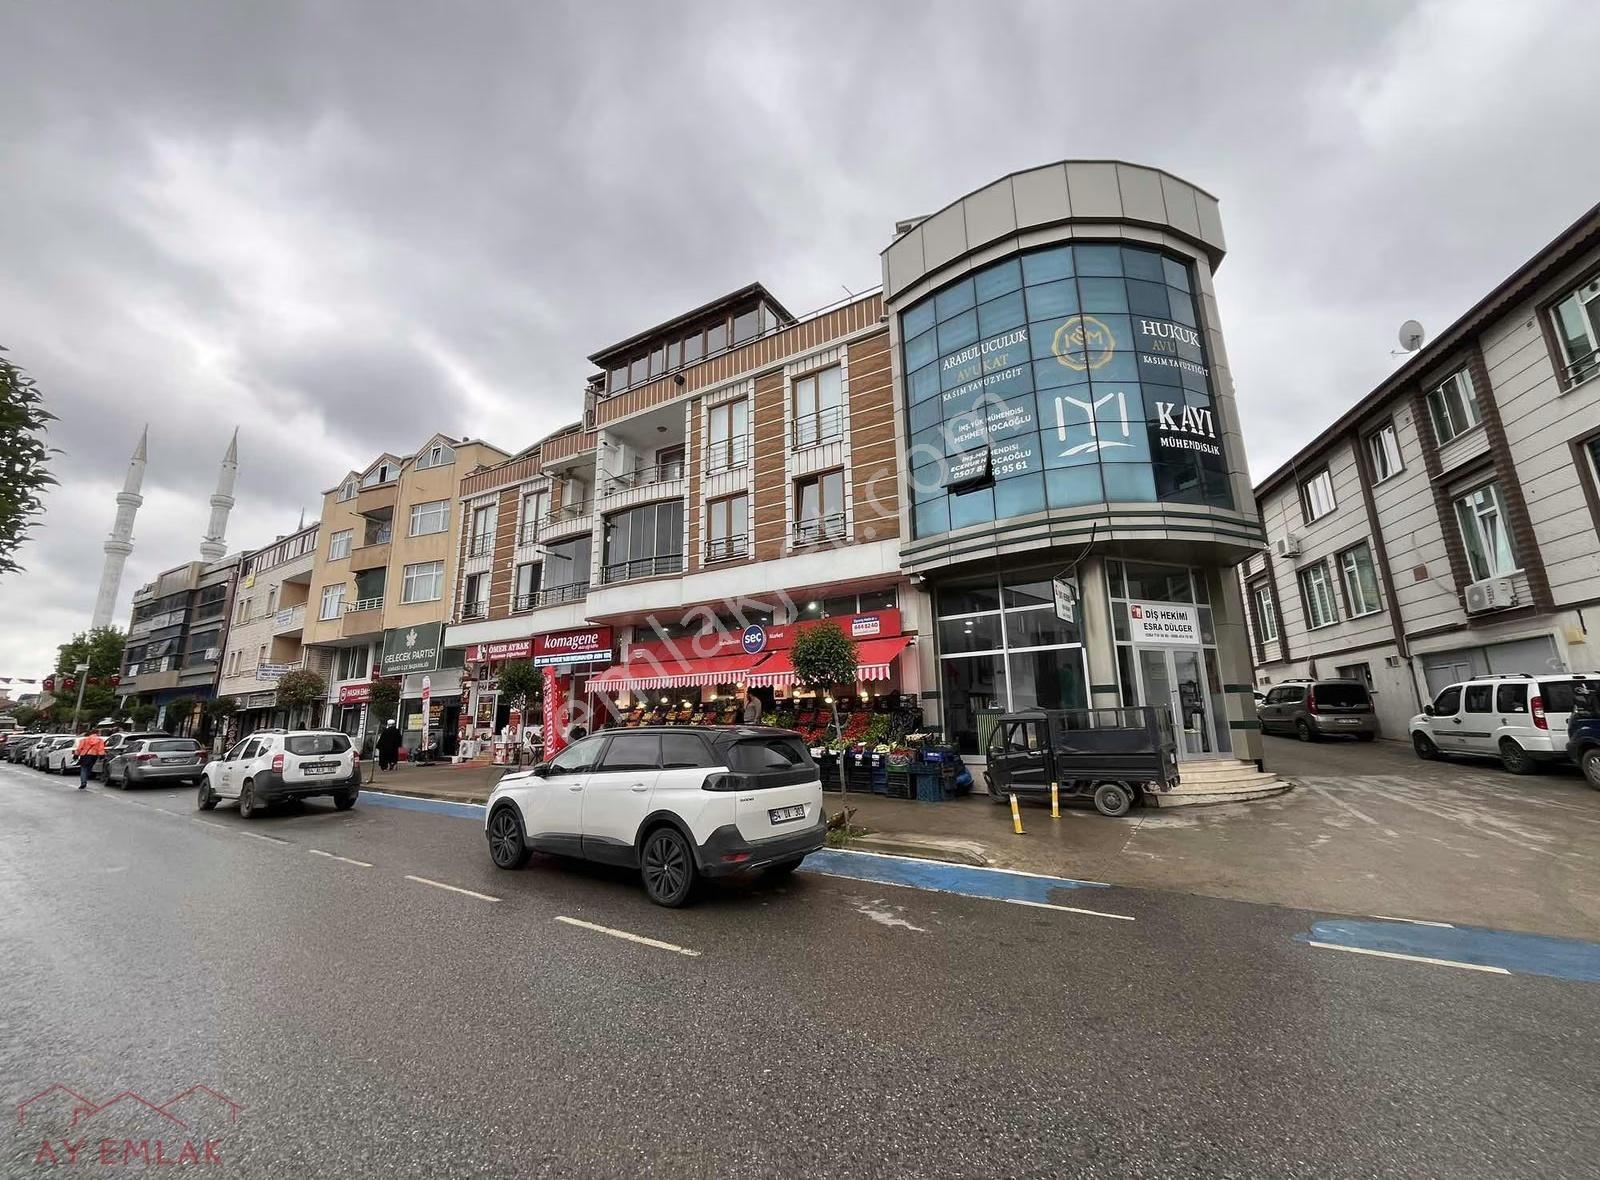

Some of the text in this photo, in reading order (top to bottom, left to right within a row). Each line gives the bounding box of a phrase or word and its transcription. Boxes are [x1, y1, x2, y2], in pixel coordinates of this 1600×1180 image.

[1141, 320, 1201, 348] HUKUK
[943, 329, 1028, 371] ARABULUCULUK
[957, 353, 1009, 382] AVUKAT
[1143, 355, 1168, 367] KASIM
[943, 385, 967, 402] KASIM
[1155, 401, 1217, 439] KAYI
[1159, 436, 1221, 456] MÜHENDİSLİK
[1015, 460, 1028, 471] 61
[1145, 609, 1188, 621] DİŞ HEKİMİ
[1143, 622, 1193, 632] ESRA DÜLGER
[544, 633, 599, 650] komagene
[384, 652, 411, 664] GELECEK
